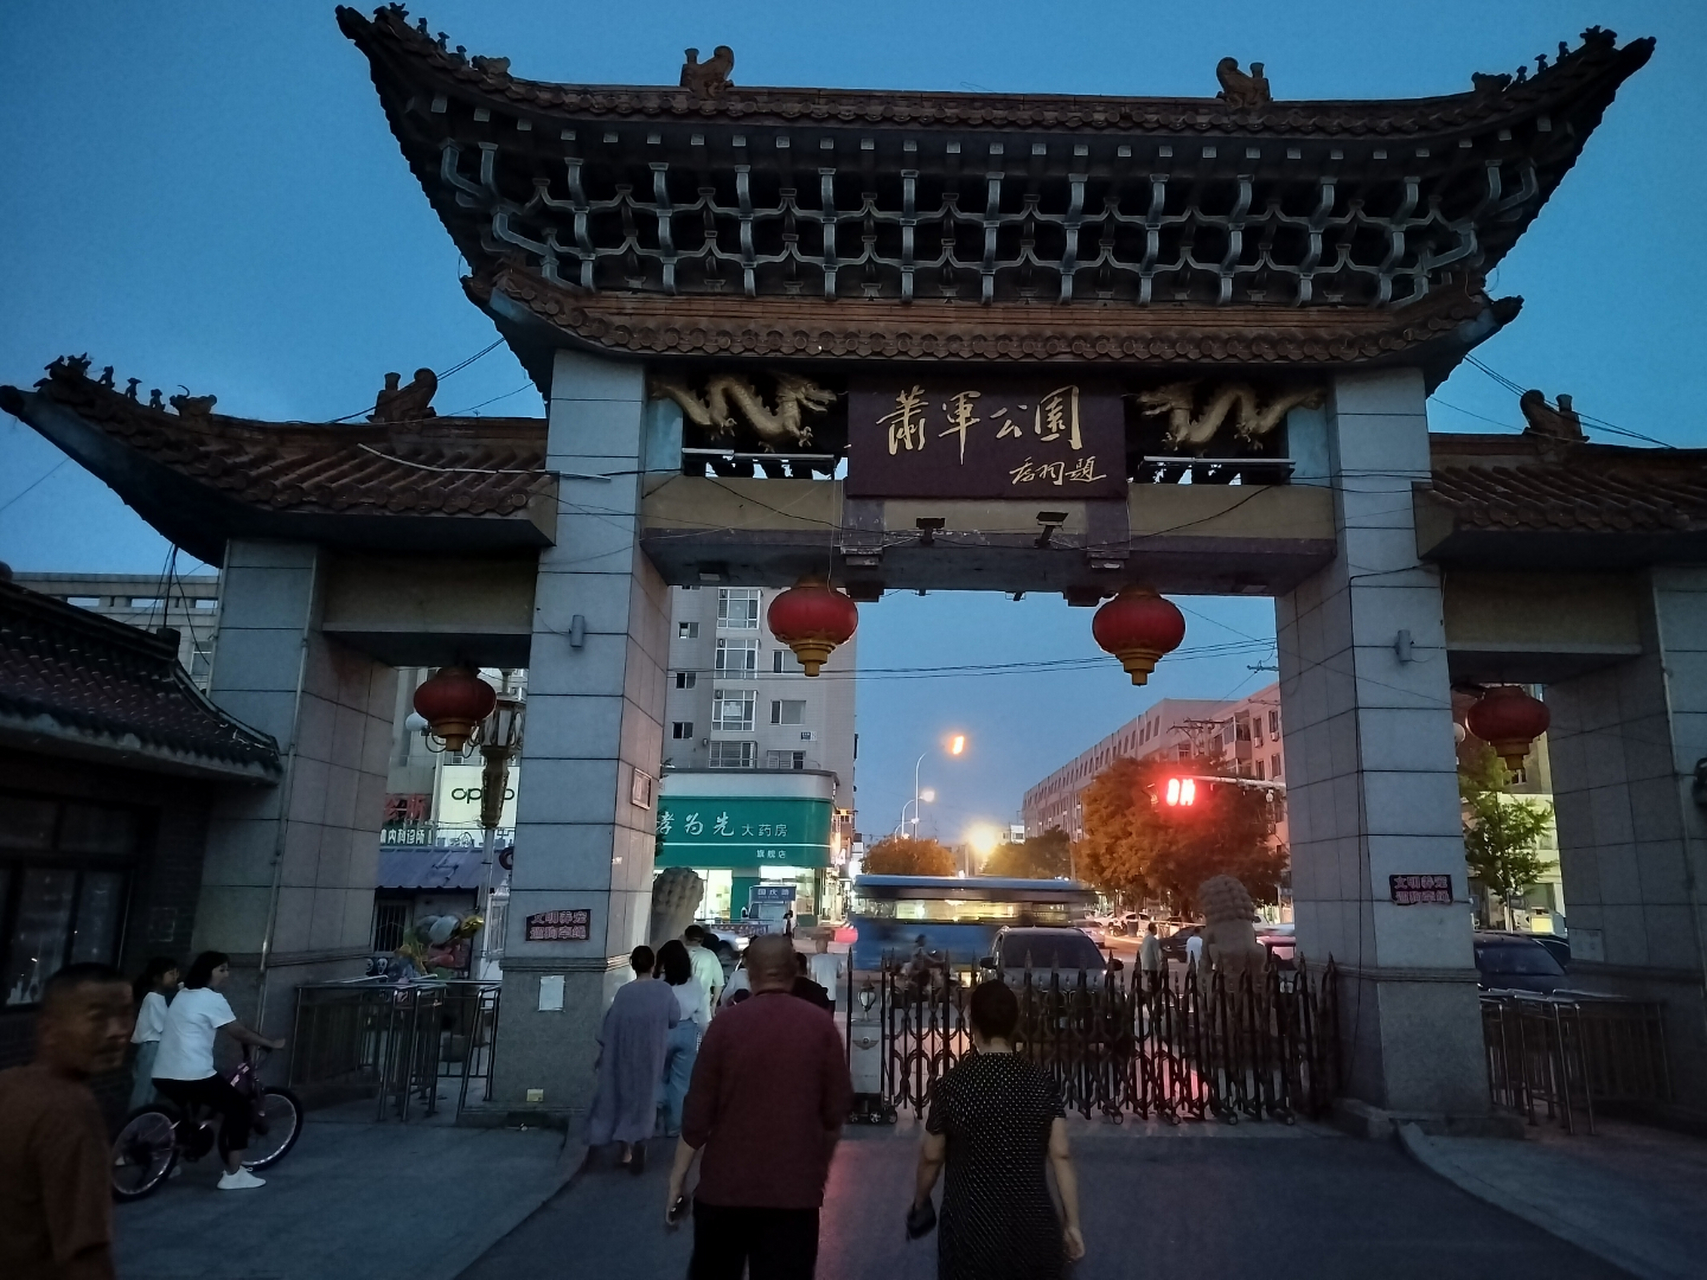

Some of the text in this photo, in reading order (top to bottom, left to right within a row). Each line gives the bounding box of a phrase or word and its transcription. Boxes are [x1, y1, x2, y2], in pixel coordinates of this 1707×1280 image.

[451, 788, 515, 804] opo
[756, 849, 786, 859] 旗舰店
